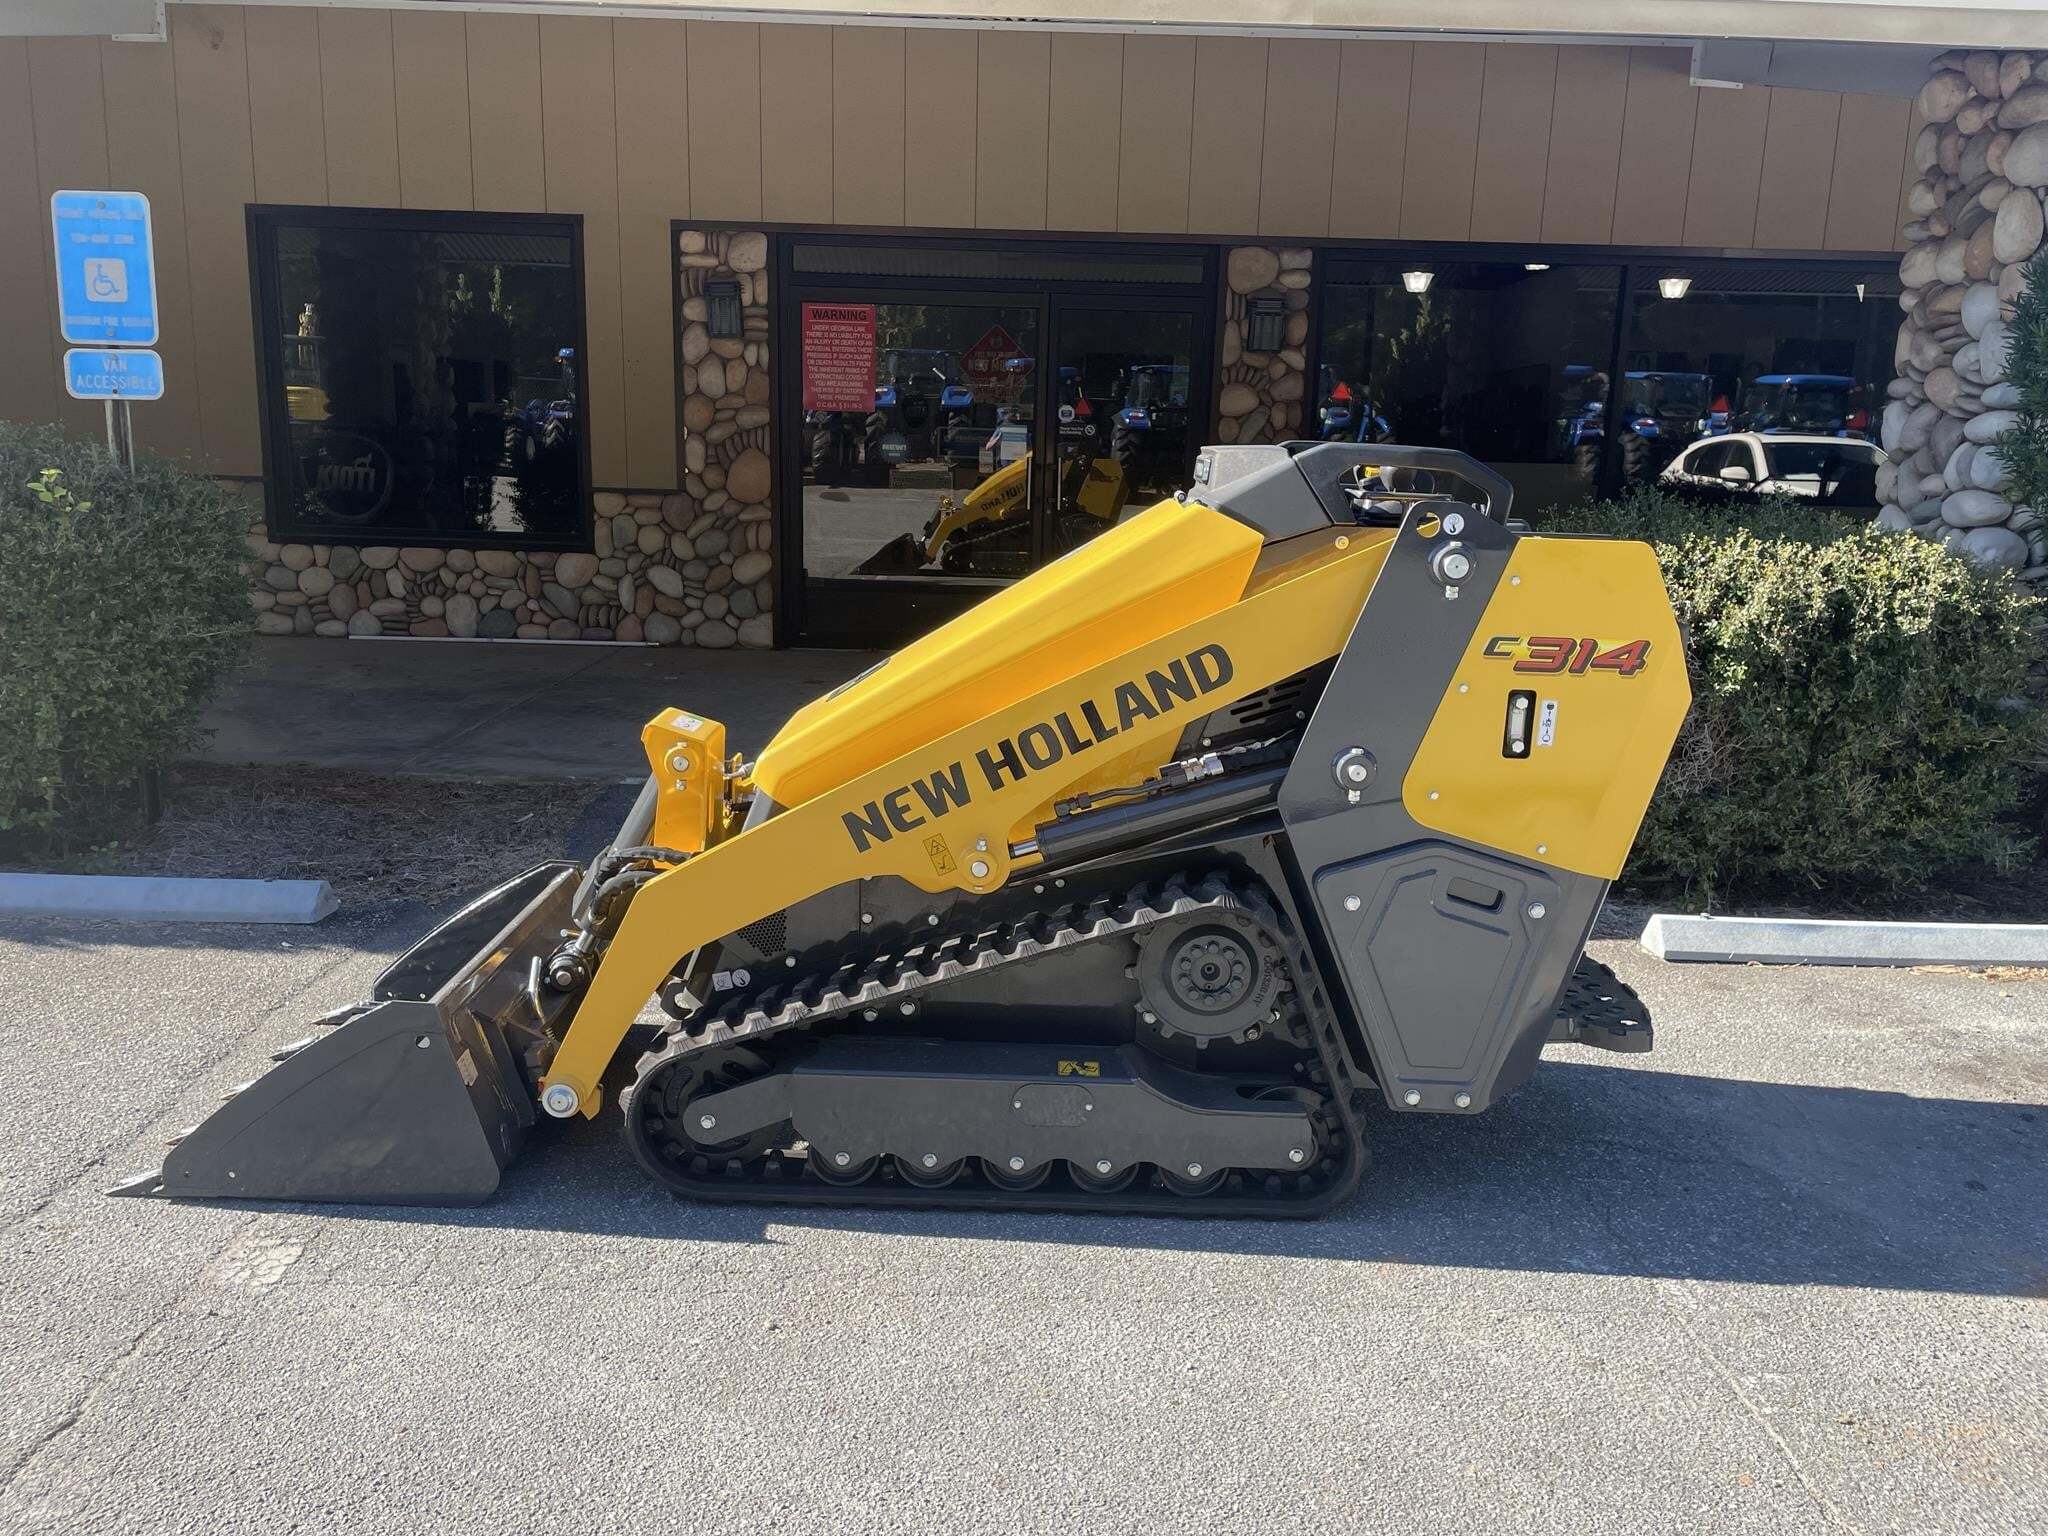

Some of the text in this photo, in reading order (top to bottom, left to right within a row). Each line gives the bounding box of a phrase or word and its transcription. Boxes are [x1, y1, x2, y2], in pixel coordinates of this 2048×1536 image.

[812, 310, 867, 321] WARNING
[102, 357, 128, 373] VAN
[76, 374, 155, 390] ACCESSIBLE
[1483, 636, 1652, 676] C314
[841, 643, 1234, 854] NEW HOLLAND
